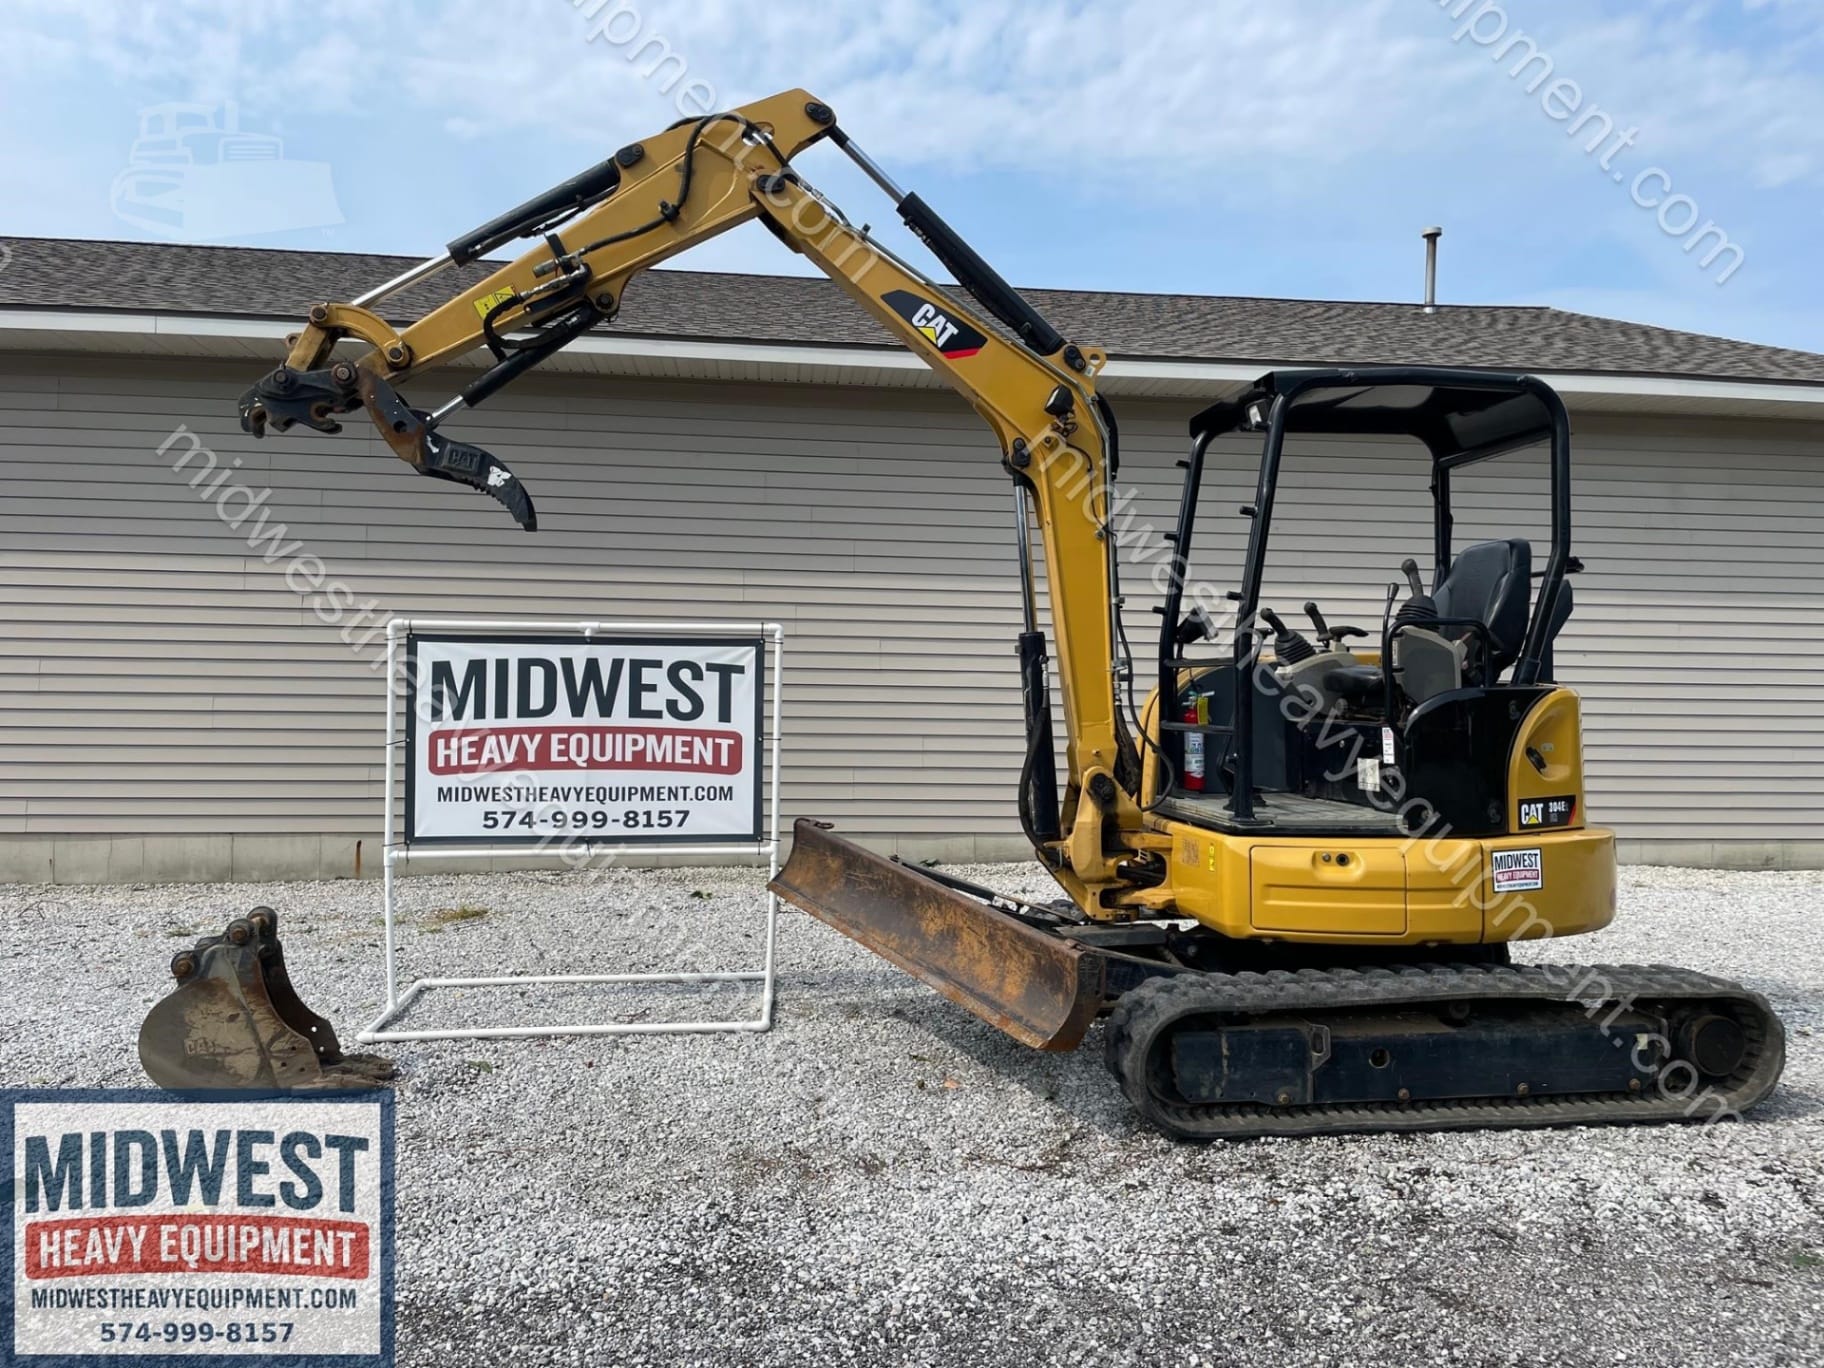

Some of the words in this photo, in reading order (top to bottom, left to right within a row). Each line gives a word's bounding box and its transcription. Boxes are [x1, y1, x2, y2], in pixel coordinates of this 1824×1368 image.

[912, 303, 959, 348] CAT
[431, 657, 745, 723] MIDWEST
[437, 733, 543, 767] HEAVY
[550, 733, 734, 767] EQUIPMENT
[437, 785, 733, 802] MIDWESTHEAVYEQUIPMENT.COM
[482, 810, 690, 829] 574-999-8157
[1521, 803, 1544, 825] CAT
[1494, 853, 1539, 871] MIDWEST
